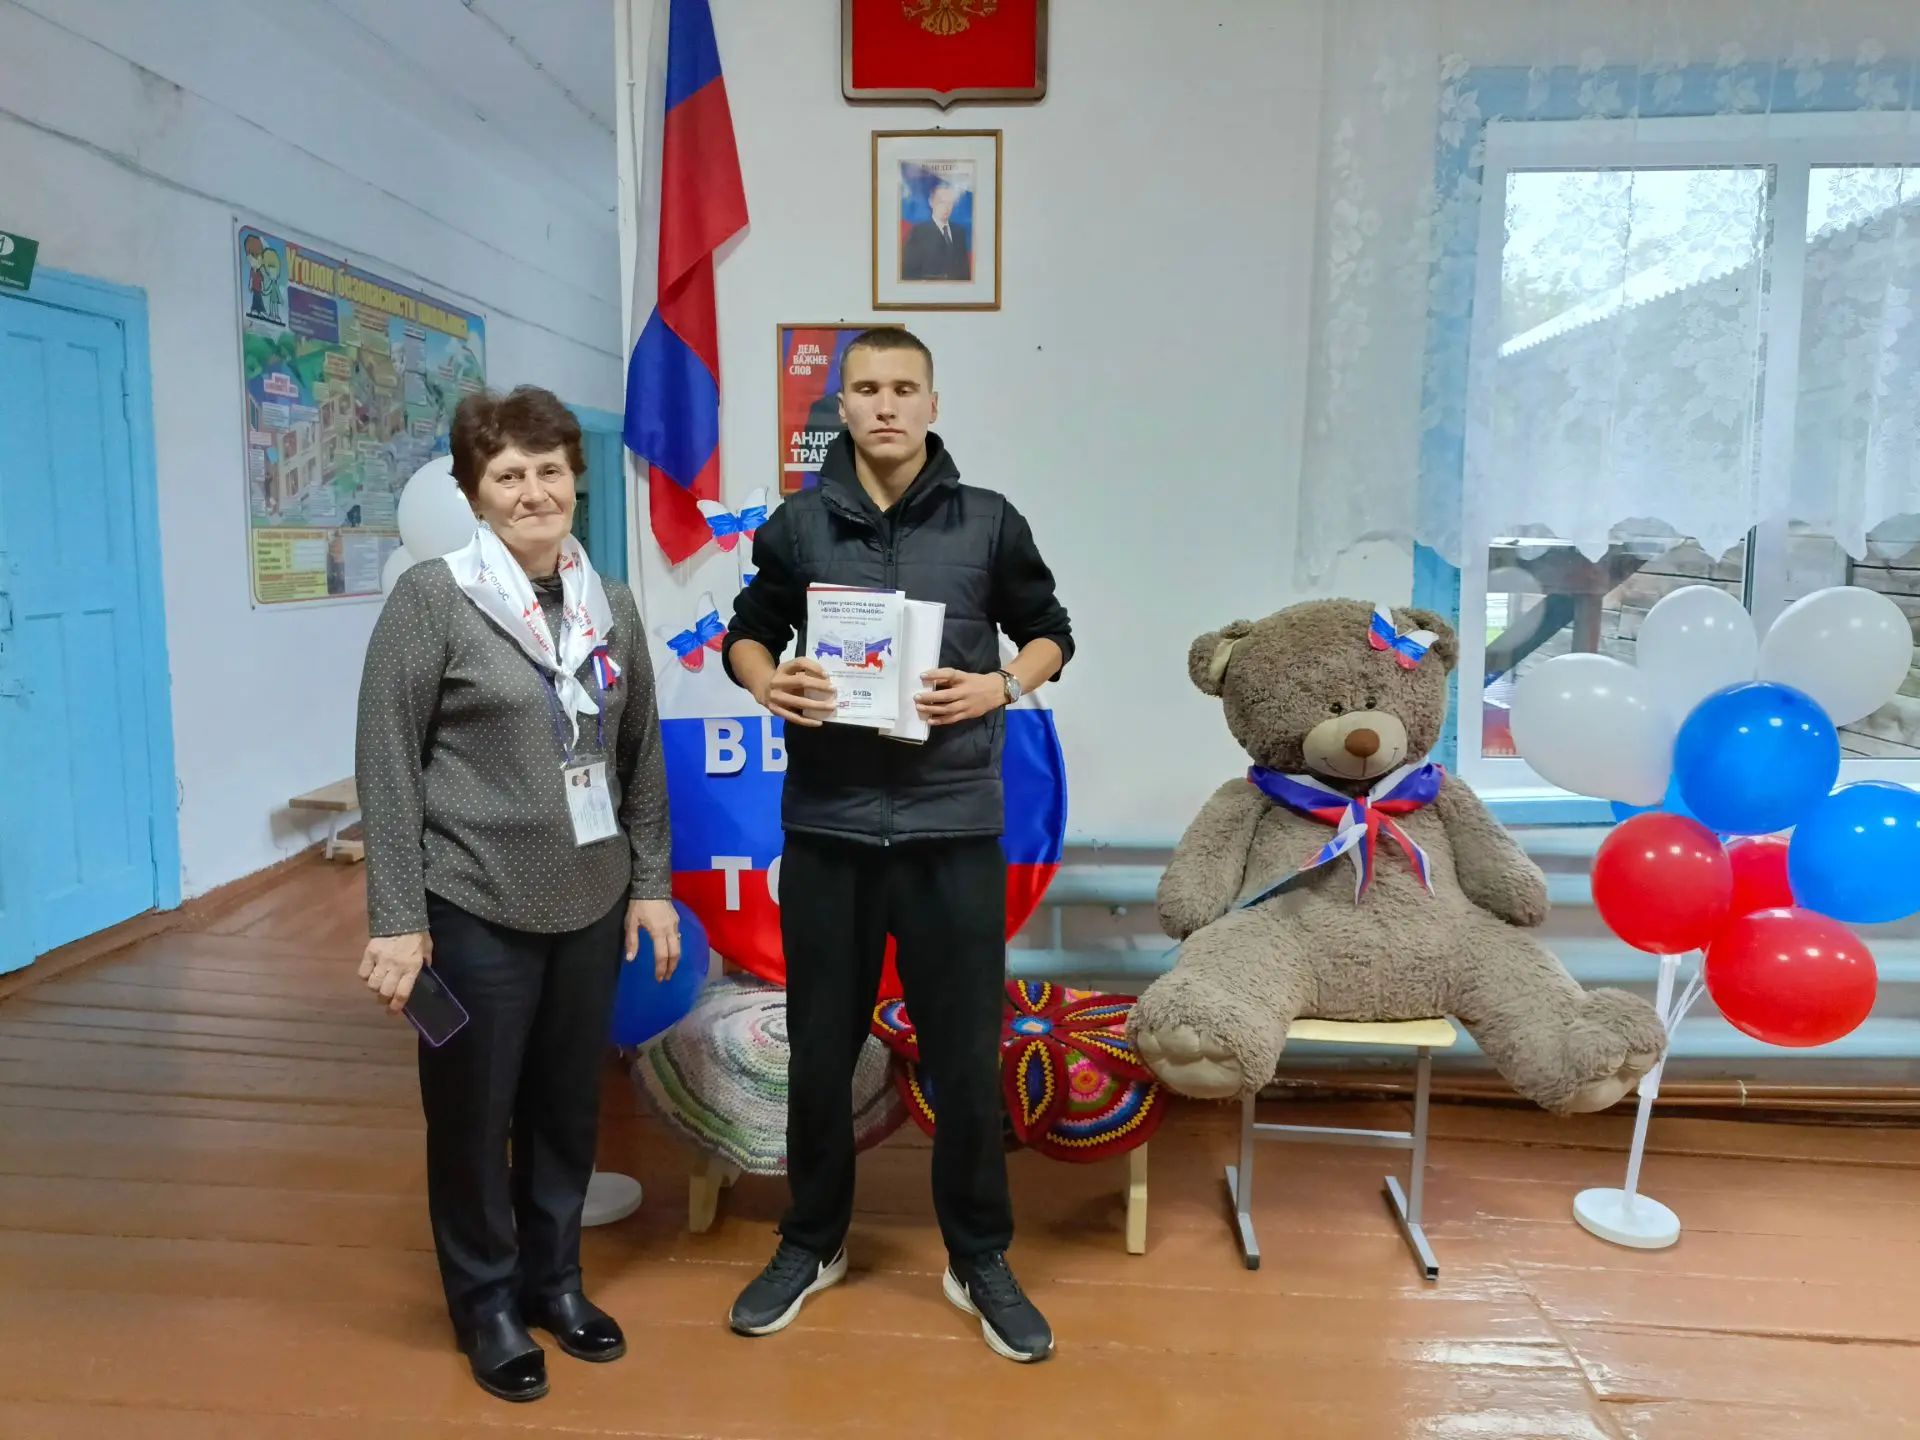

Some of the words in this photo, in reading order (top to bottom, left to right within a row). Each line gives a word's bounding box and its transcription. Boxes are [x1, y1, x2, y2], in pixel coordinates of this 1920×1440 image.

[285, 246, 334, 293] Уголок
[797, 344, 820, 355] ДЕЛА
[793, 355, 828, 365] ВАЖНЕЕ
[789, 365, 812, 375] СЛОВ
[790, 431, 840, 448] АНДР
[852, 689, 872, 697] БУДЬ
